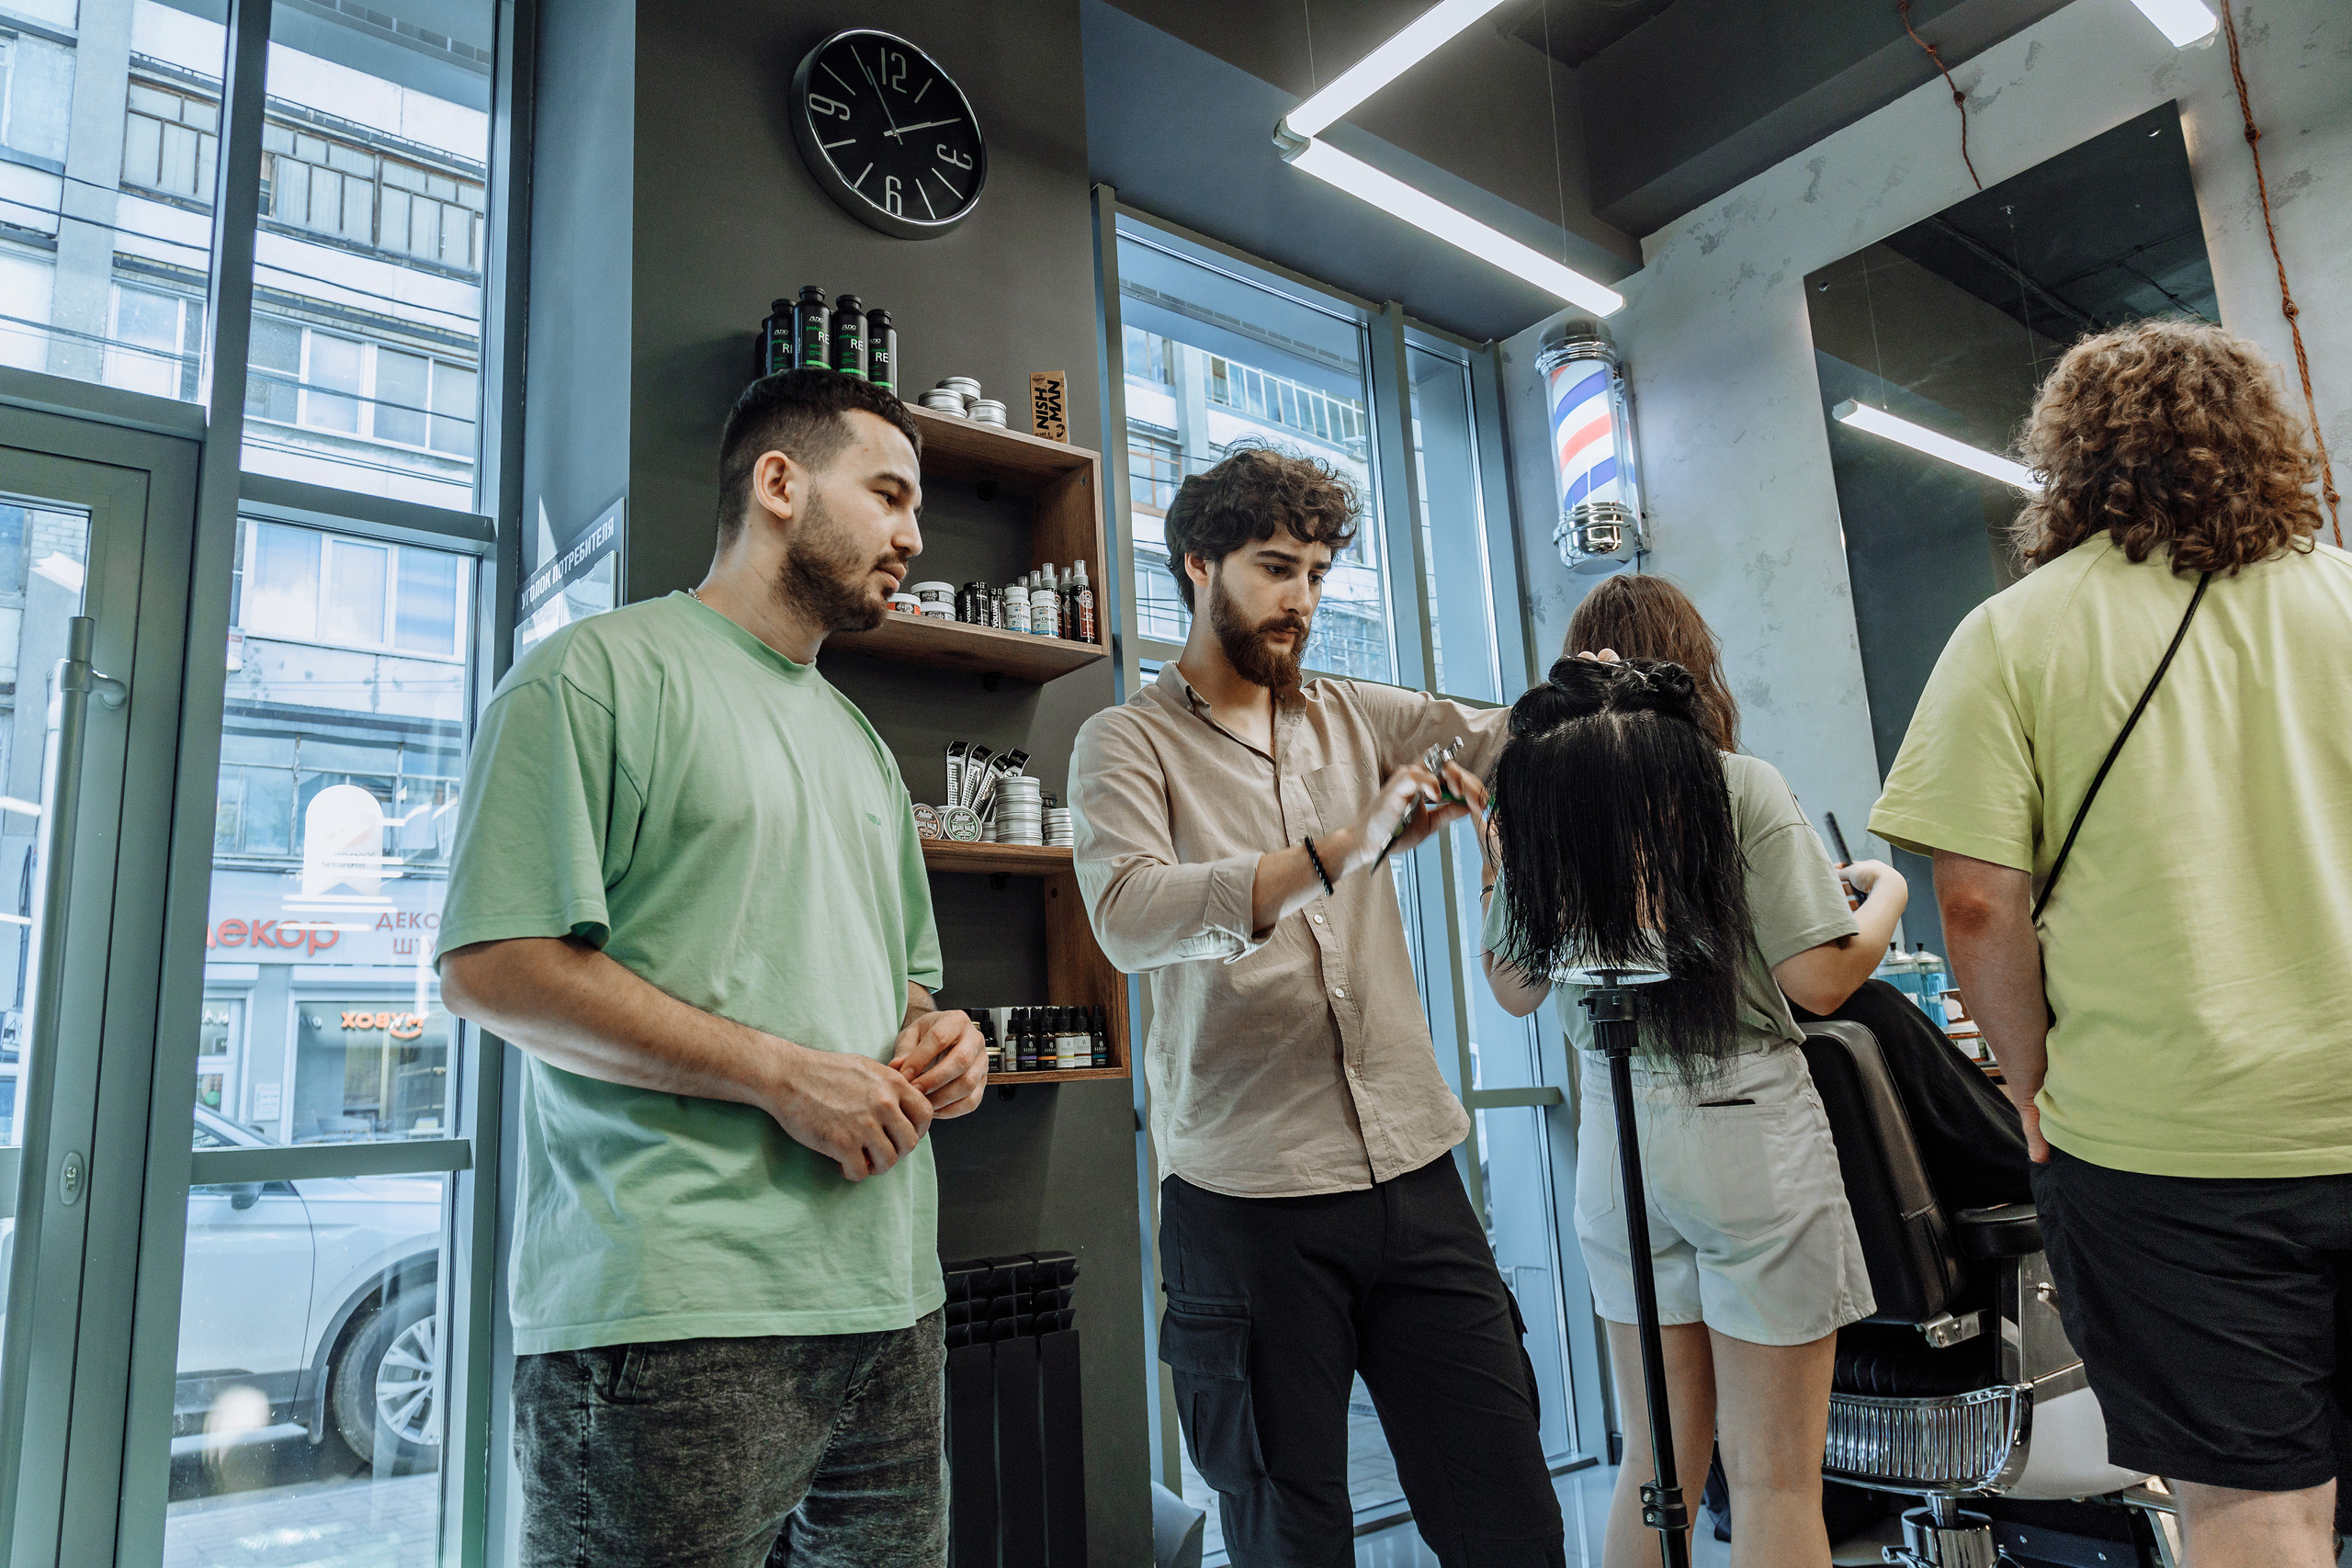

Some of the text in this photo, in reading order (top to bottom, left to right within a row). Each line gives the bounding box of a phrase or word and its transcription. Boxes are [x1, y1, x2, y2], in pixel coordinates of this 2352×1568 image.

[881, 47, 907, 94] 12
[808, 93, 851, 121] 9
[936, 143, 973, 171] 3
[885, 175, 902, 216] 6
[818, 331, 830, 345] RE
[851, 338, 864, 352] RE
[876, 352, 889, 364] RE
[1035, 387, 1049, 430] NISH
[1047, 379, 1062, 422] MAN
[521, 516, 615, 611] УГОЛОК ПОТРЕБИТЕЛЯ
[375, 912, 441, 931] ДЕКО
